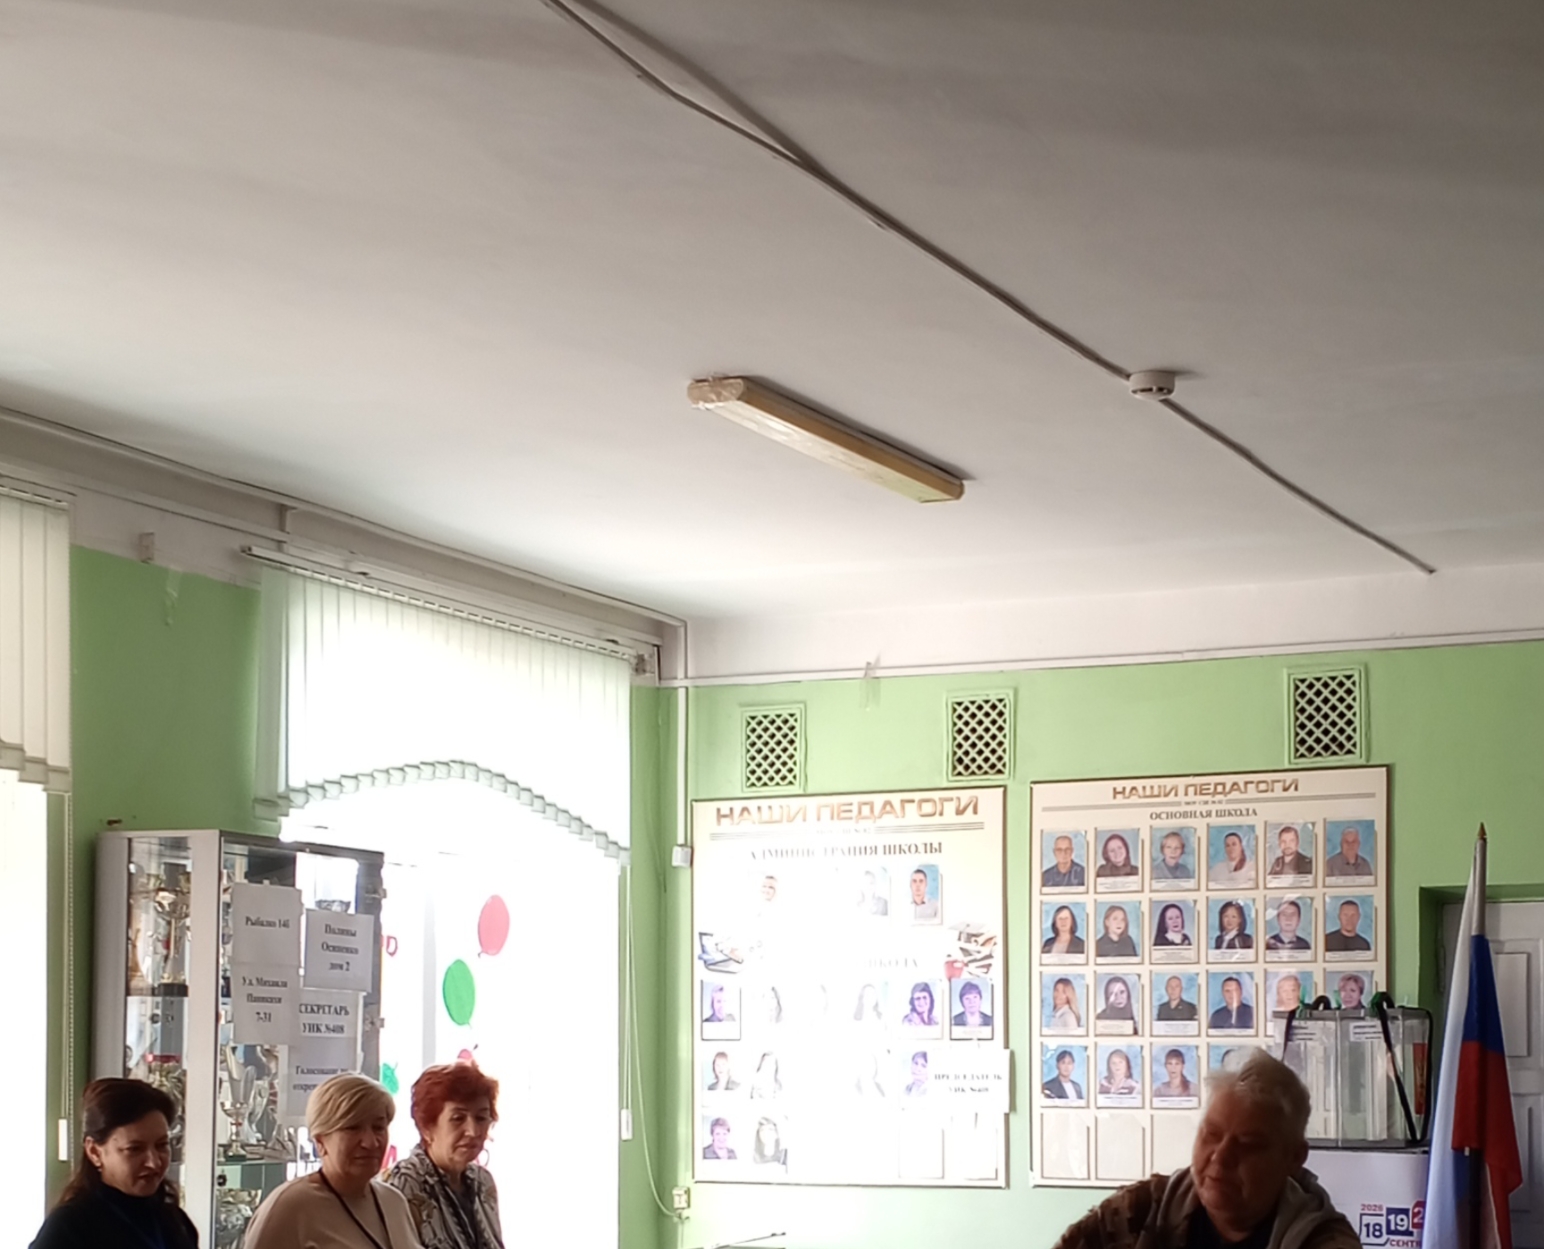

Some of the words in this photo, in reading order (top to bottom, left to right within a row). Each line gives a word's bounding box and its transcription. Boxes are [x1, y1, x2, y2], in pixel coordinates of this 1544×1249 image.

[1113, 785, 1179, 800] НАШИ
[1184, 778, 1299, 798] ПЕДАГОГИ
[716, 804, 807, 826] НАШИ
[816, 796, 979, 823] ПЕДАГОГИ
[1149, 810, 1213, 820] ОСНОВНАЯ
[1215, 807, 1258, 818] ШКОЛА
[883, 841, 943, 855] ШКОЛЫ
[324, 923, 357, 938] Полины
[321, 941, 359, 955] Осипенко
[345, 961, 350, 972] 2
[299, 1003, 350, 1016] СЕКРЕТАРЬ
[302, 1022, 323, 1034] УИК
[1361, 1203, 1383, 1212] 2026
[1363, 1222, 1383, 1238] 18
[1387, 1214, 1409, 1231] 19
[1389, 1239, 1422, 1248] СЕНТЯ
